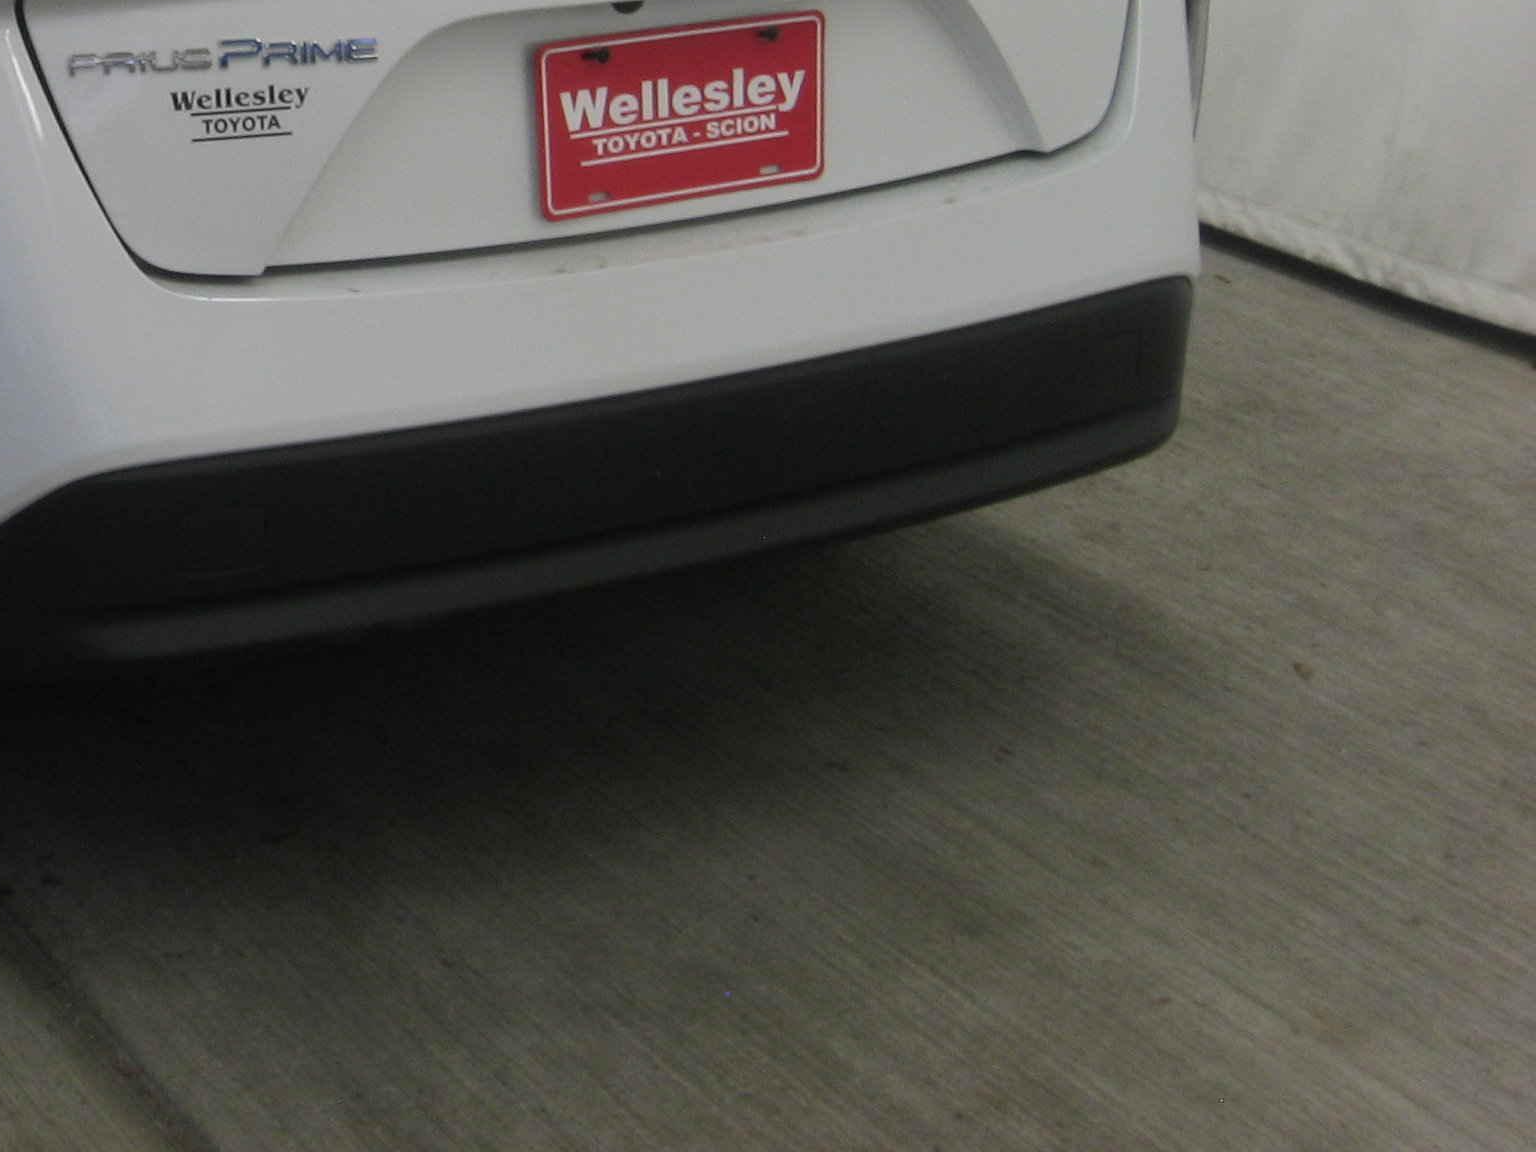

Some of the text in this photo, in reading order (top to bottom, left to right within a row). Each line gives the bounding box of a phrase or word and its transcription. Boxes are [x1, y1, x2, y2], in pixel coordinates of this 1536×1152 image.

[68, 38, 378, 77] PRIUS PRIME
[170, 85, 309, 111] Wellesley
[559, 68, 805, 132] Wellesley
[202, 115, 281, 134] TOYOTA
[593, 127, 688, 156] TOYOTA
[706, 113, 777, 139] SCION
